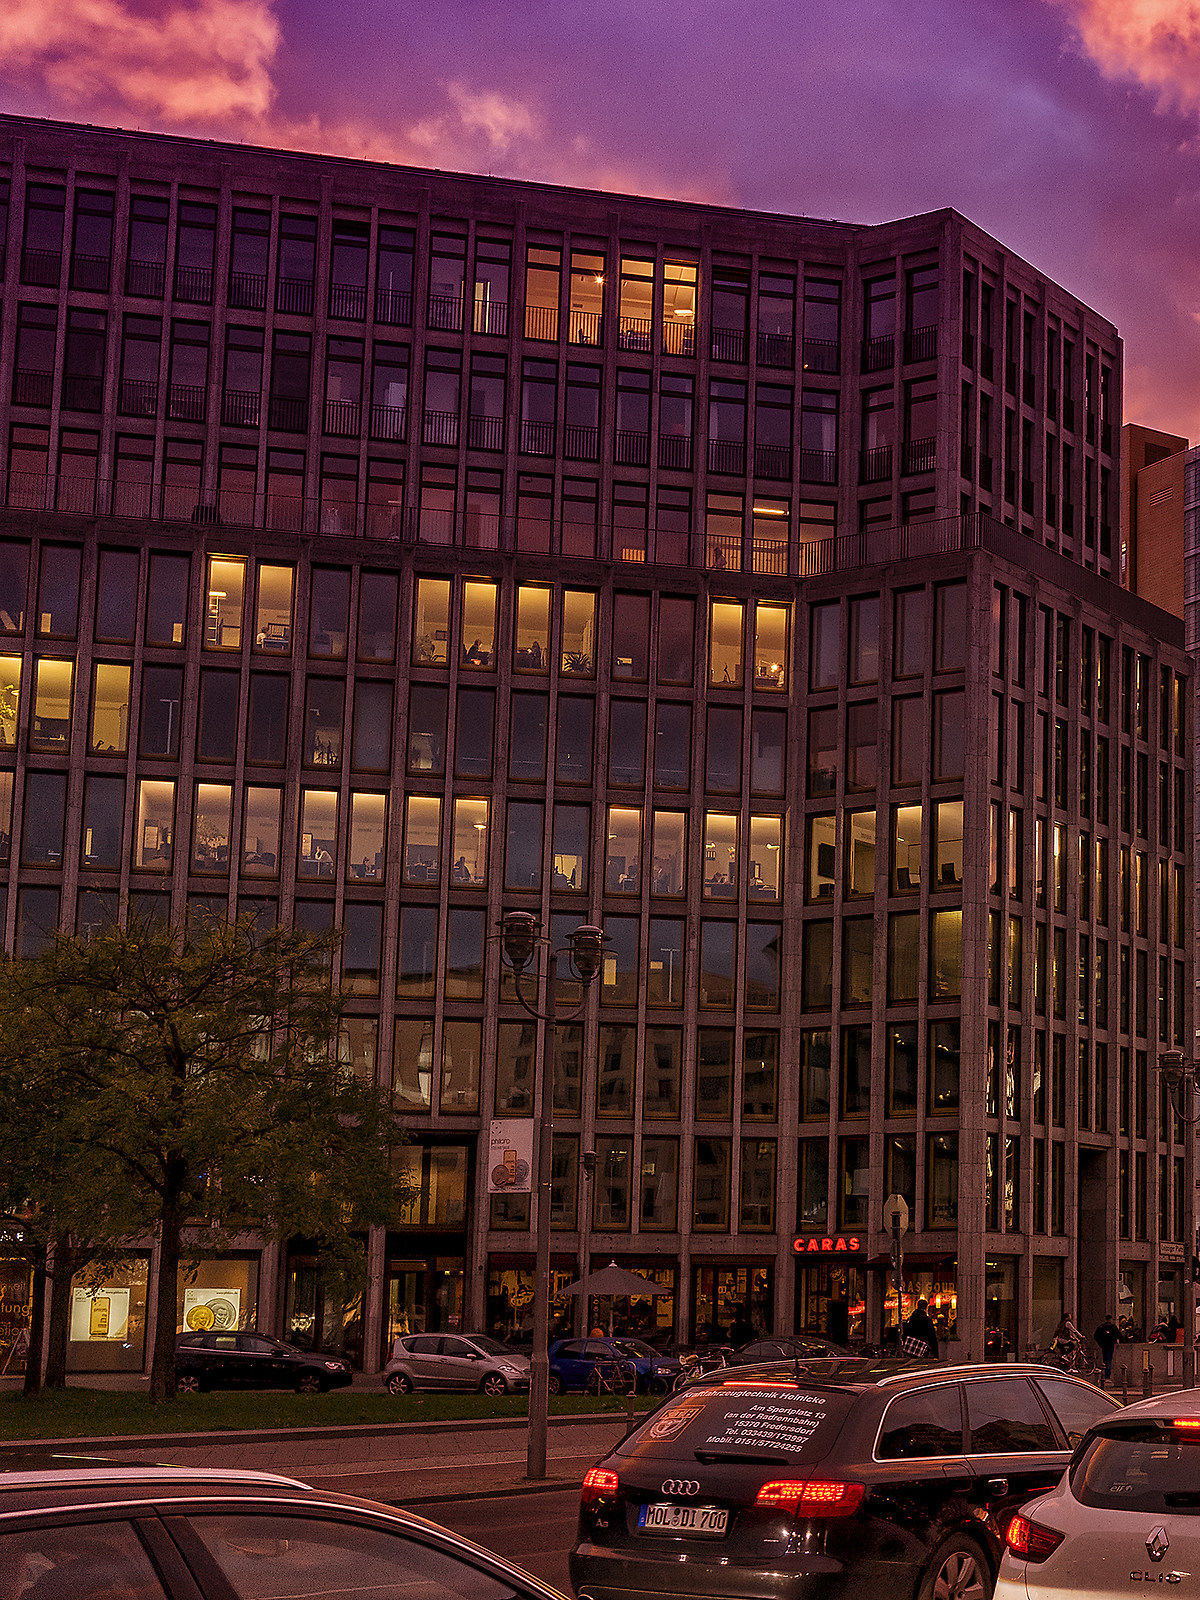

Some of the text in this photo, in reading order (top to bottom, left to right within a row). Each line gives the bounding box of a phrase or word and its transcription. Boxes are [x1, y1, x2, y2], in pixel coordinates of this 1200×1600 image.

[793, 1236, 861, 1252] CARAS
[724, 1412, 739, 1420] (an
[755, 1412, 820, 1428] Radrennbahn)
[750, 1404, 826, 1420] Am Sportplatz 13
[724, 1428, 739, 1436] Tel.
[734, 1420, 815, 1436] 15370 Fredersdorf
[706, 1436, 733, 1444] Mobil:
[647, 1507, 727, 1529] MOL DI 700
[1129, 1569, 1182, 1584] CLIO
